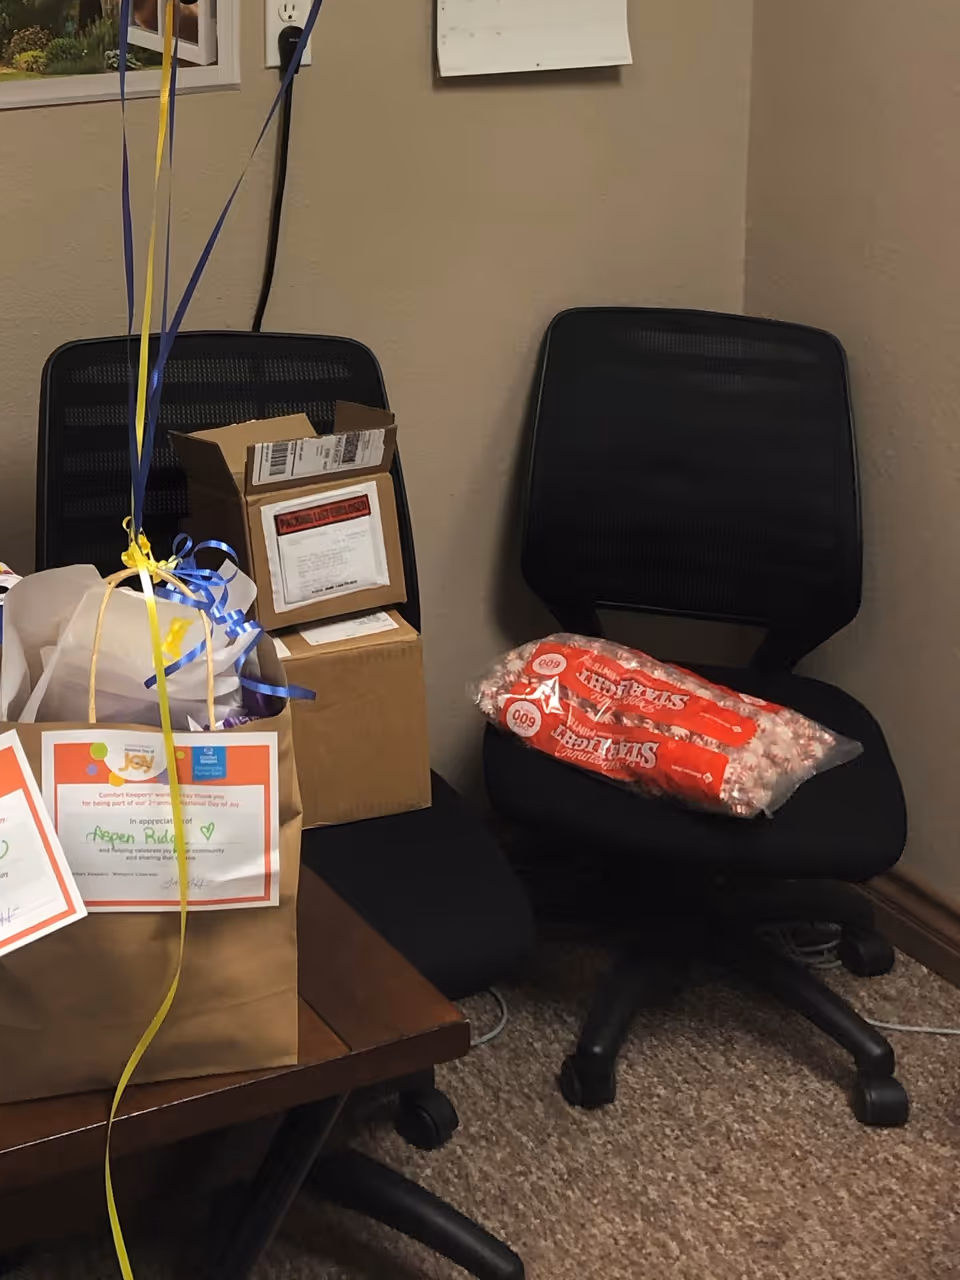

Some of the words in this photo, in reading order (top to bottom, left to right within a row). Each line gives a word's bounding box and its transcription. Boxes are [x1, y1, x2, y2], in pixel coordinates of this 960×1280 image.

[539, 659, 560, 668] 600
[512, 709, 536, 728] 600
[551, 724, 659, 768] STARLIGHT
[86, 825, 135, 849] Aspen
[143, 826, 177, 854] Ridg
